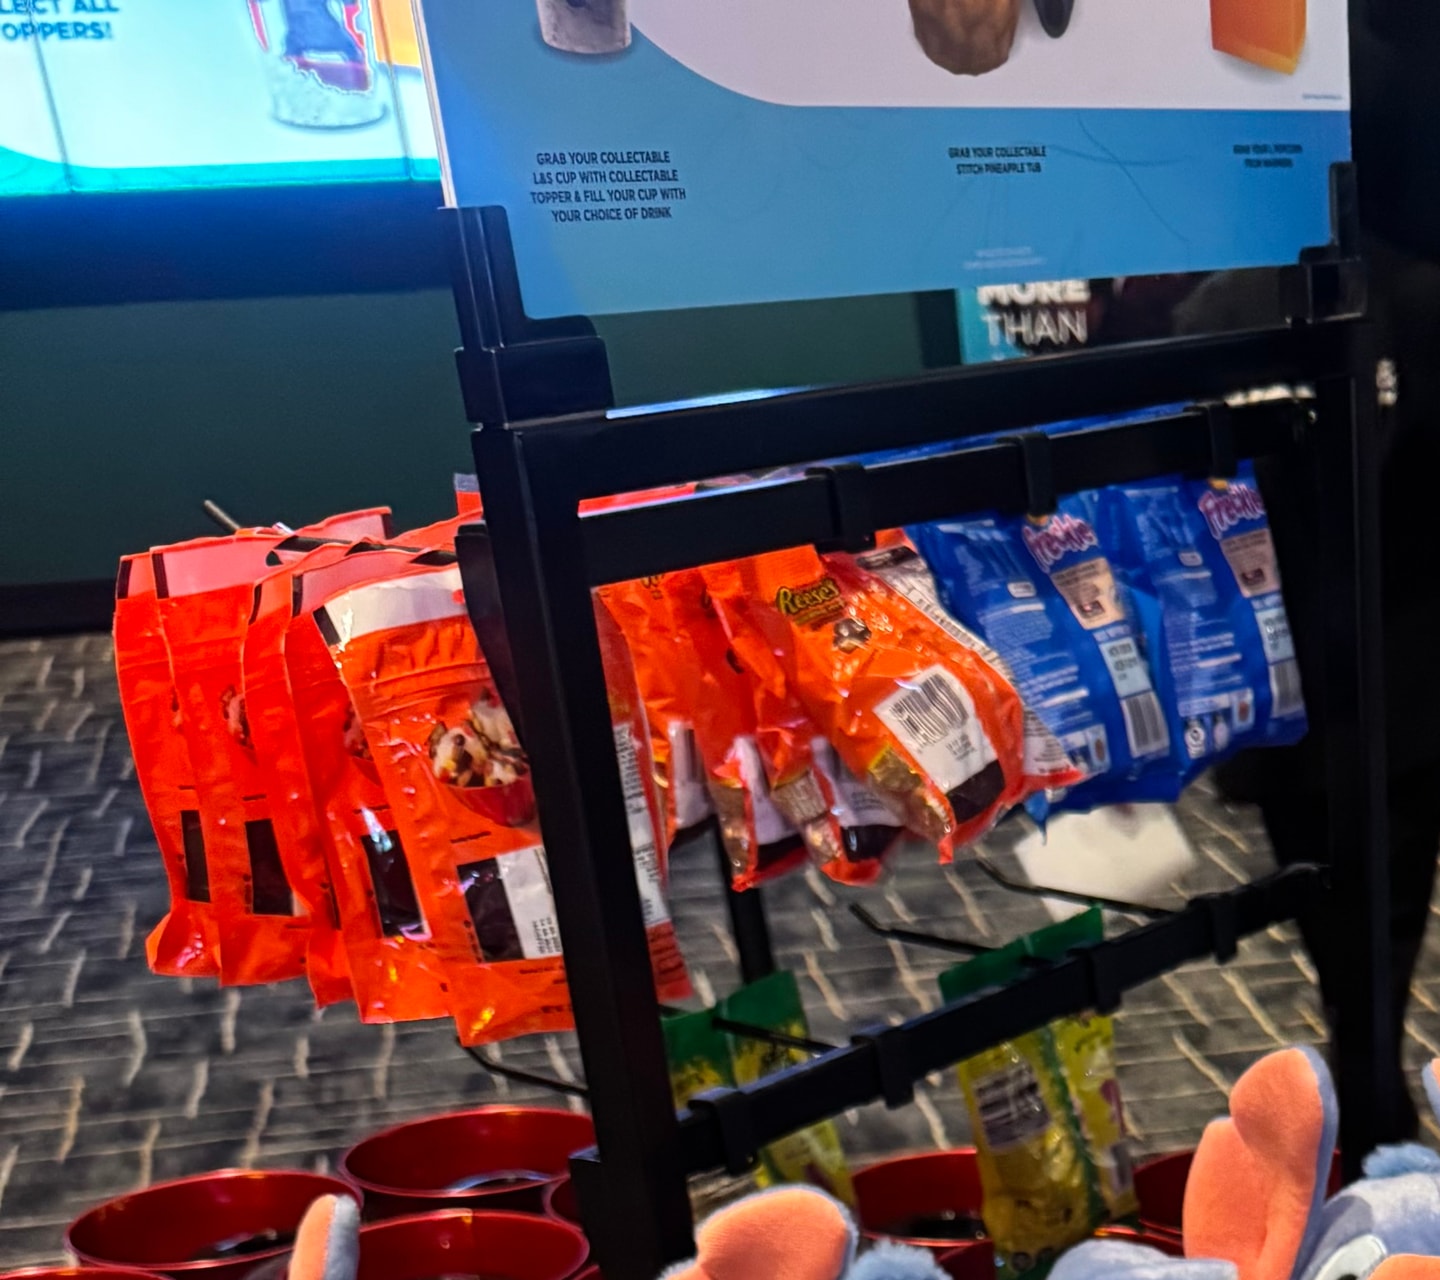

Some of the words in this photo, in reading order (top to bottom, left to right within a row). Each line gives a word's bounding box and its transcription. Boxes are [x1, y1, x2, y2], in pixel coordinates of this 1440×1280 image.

[536, 152, 566, 165] GRAB
[568, 152, 598, 164] YOUR
[600, 151, 670, 164] COLLECTABLE
[533, 172, 553, 185] L&S
[556, 171, 577, 184] CUP
[579, 170, 606, 183] WITH
[609, 169, 679, 183] COLLECTABLE
[530, 191, 571, 204] TOPPER
[584, 190, 606, 202] FILL
[607, 189, 635, 202] YOUR
[638, 188, 657, 201] CUP
[660, 188, 686, 200] WITH
[551, 209, 581, 223] YOUR
[584, 208, 622, 221] CHOICE
[624, 207, 638, 220] OF
[641, 206, 672, 219] DRINK
[982, 308, 1088, 346] THAN
